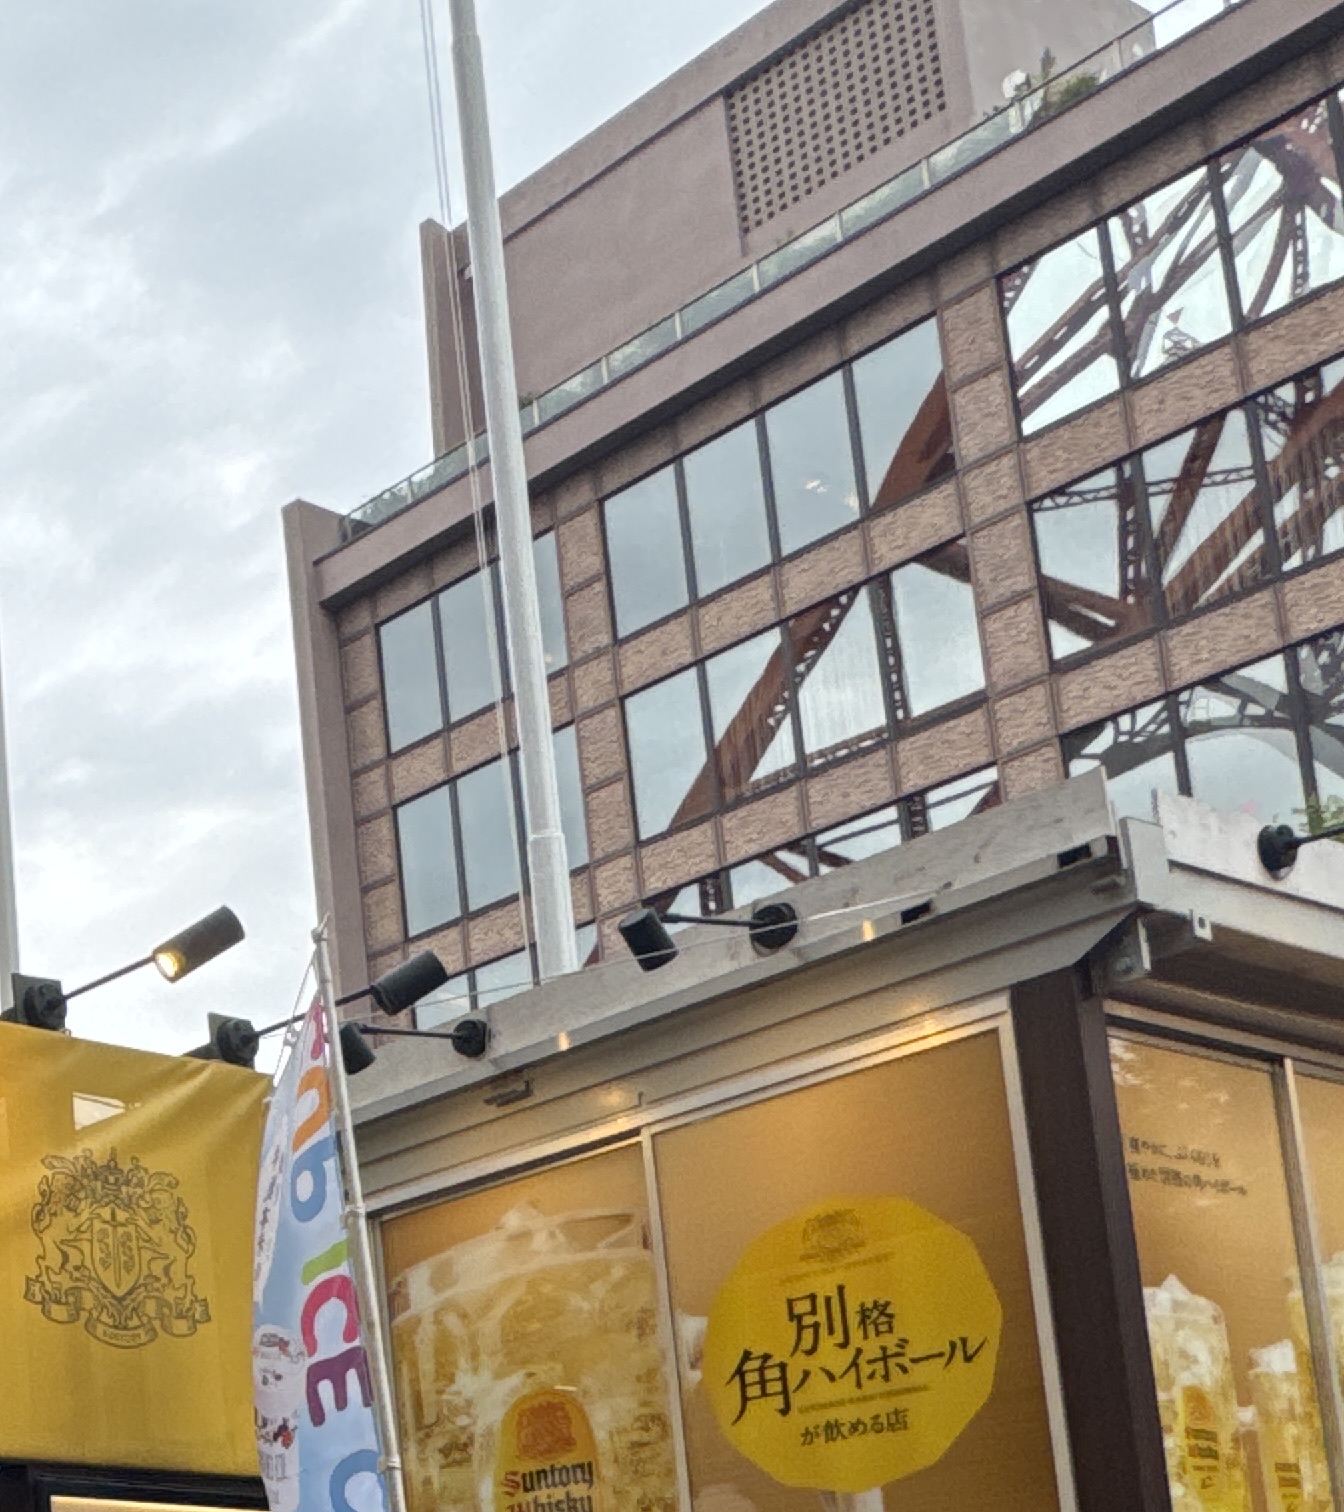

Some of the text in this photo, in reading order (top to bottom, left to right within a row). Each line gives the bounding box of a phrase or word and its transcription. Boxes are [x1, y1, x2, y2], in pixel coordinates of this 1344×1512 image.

[786, 1284, 896, 1358] 別格
[724, 1335, 989, 1426] 角ハイボール
[799, 1407, 910, 1447] が飲める店
[500, 1460, 594, 1498] Suntory
